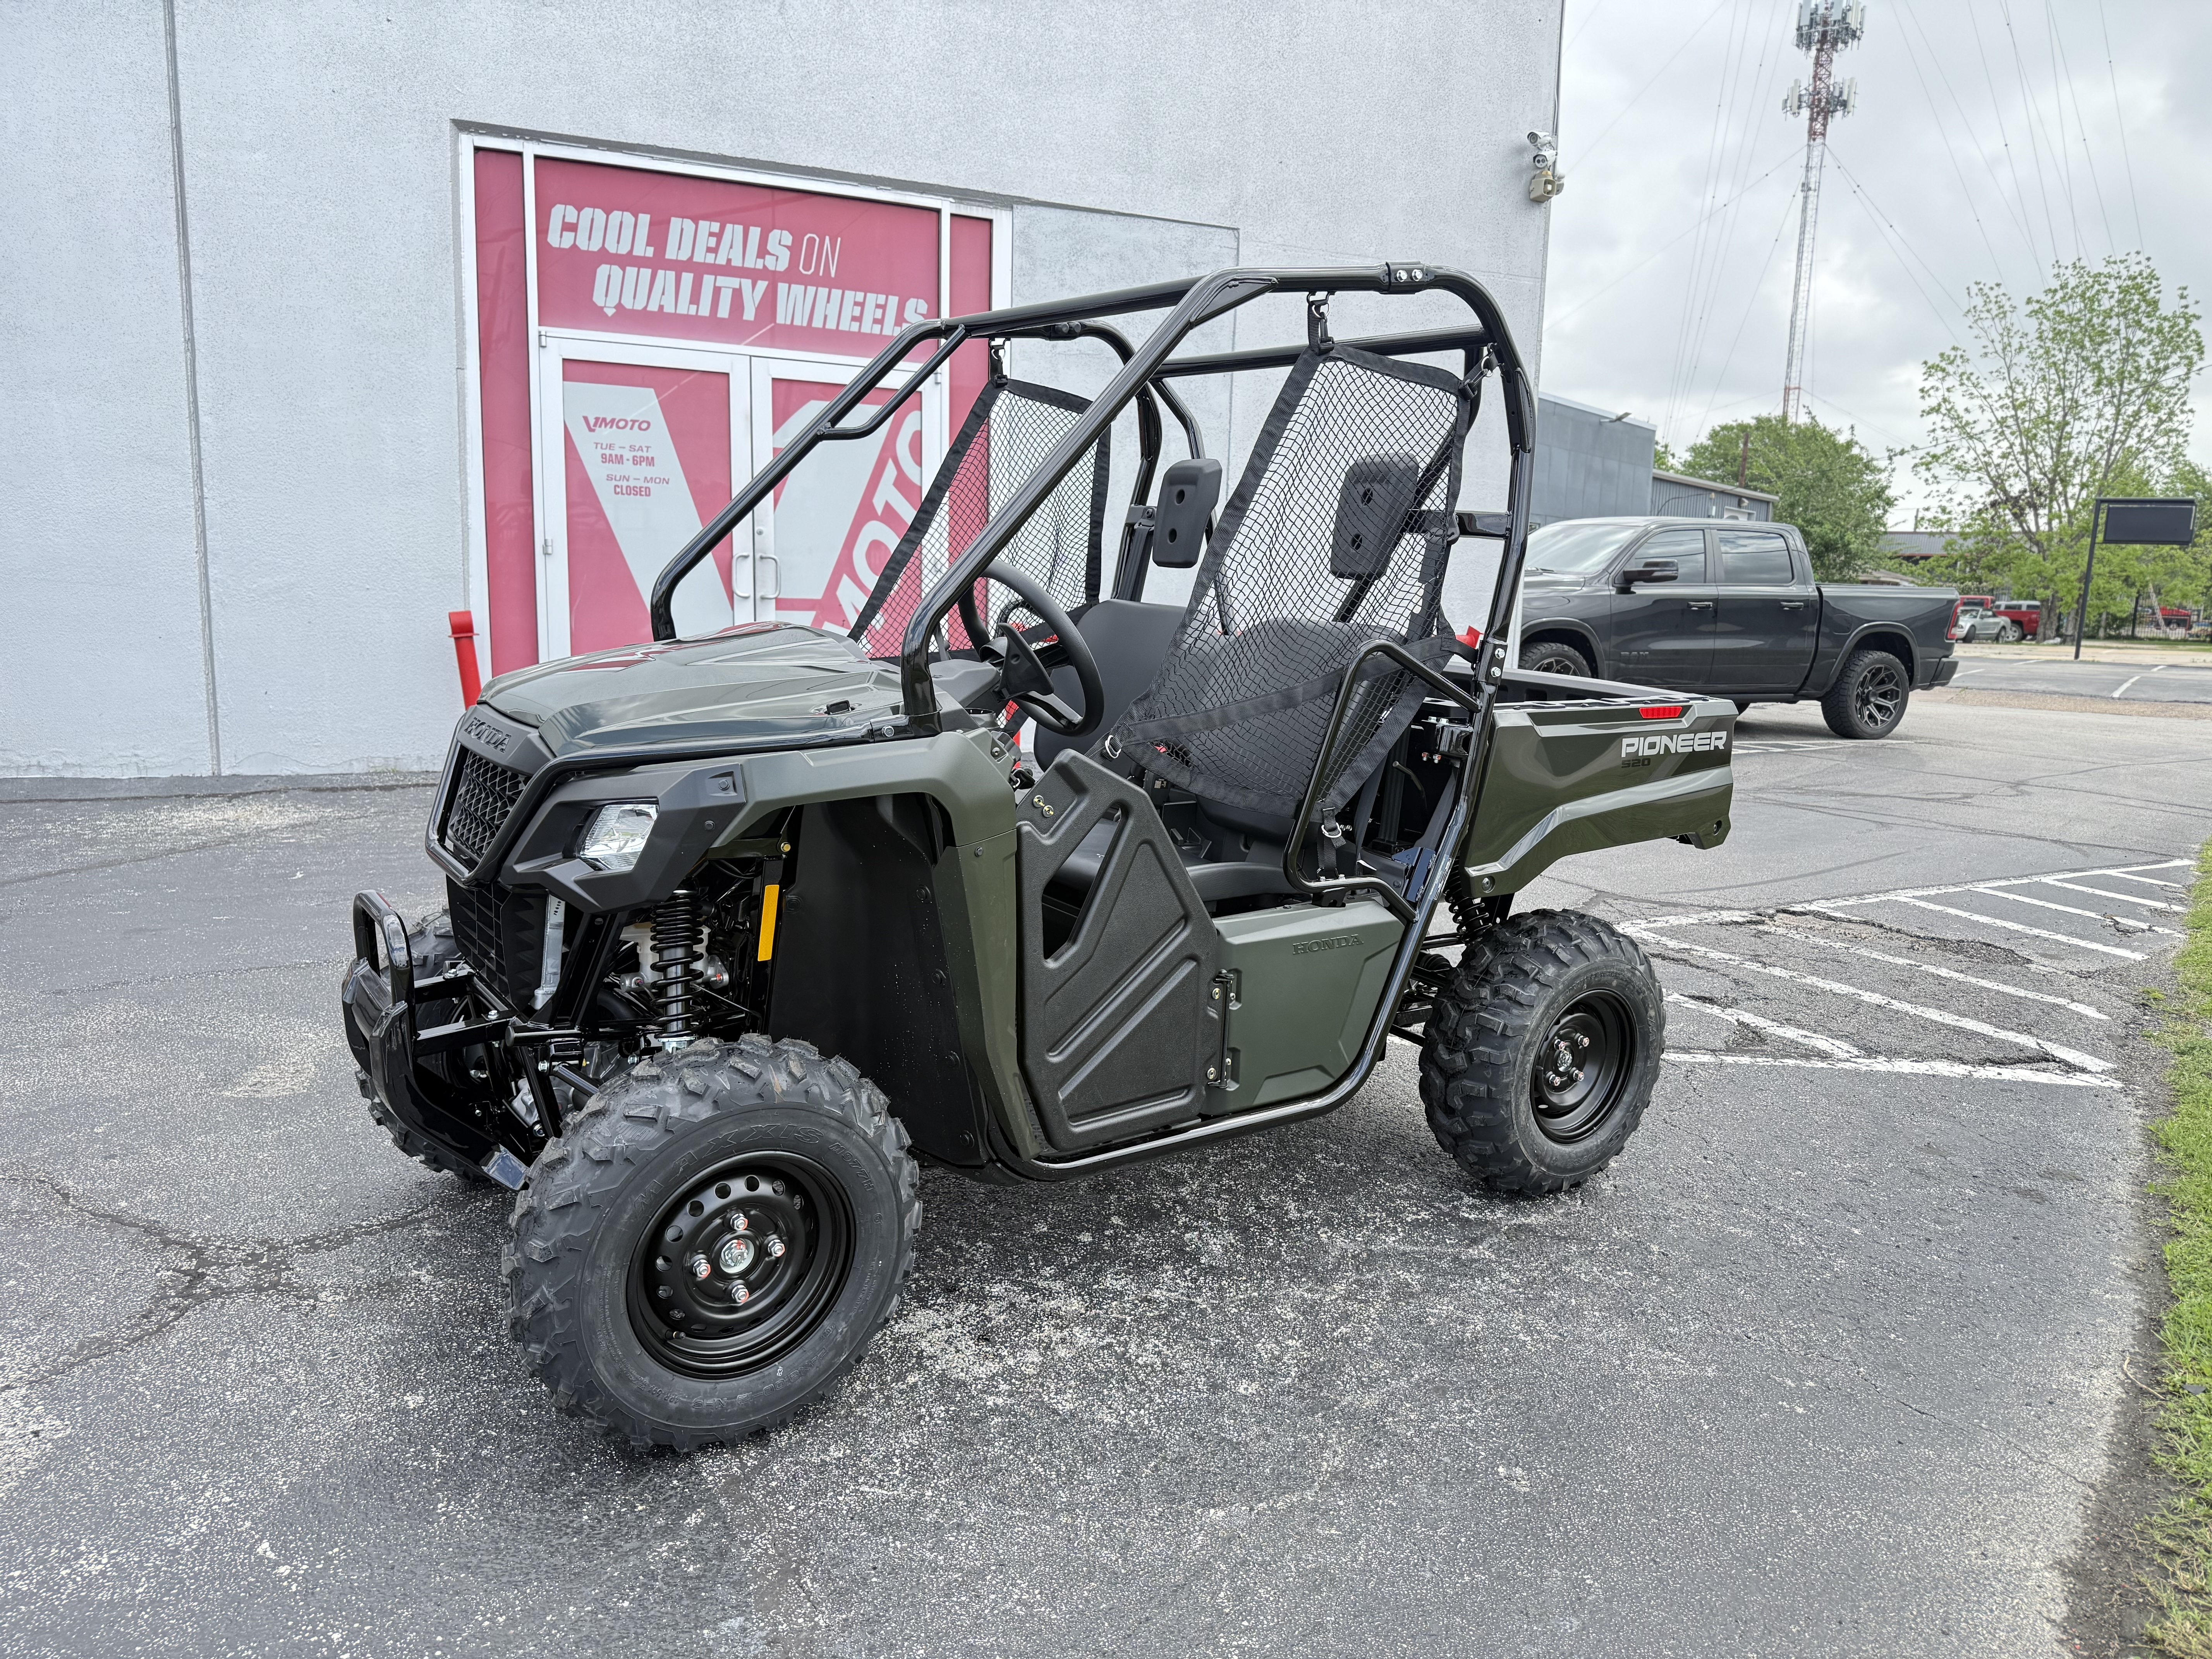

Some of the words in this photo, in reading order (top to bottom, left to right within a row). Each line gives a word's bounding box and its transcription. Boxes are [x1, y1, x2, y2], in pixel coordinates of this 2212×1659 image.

[547, 204, 654, 258] COOL
[665, 217, 793, 272] DEALS
[799, 233, 841, 278] ON
[592, 264, 768, 321] QUALITY
[776, 282, 928, 336] WHEELS
[593, 442, 615, 451] TUE
[629, 445, 651, 453] SAT
[601, 453, 624, 465] 9AM
[632, 455, 655, 467] 6PM
[606, 474, 630, 482] SUN
[643, 476, 670, 485] MON
[614, 484, 651, 497] CLOSED
[464, 717, 512, 753] HONDA
[1621, 731, 1727, 758] PIONEER
[1621, 757, 1651, 768] 520
[1292, 934, 1364, 955] HONDA
[634, 1123, 824, 1214] MAXXIS
[828, 1142, 875, 1192] M977H
